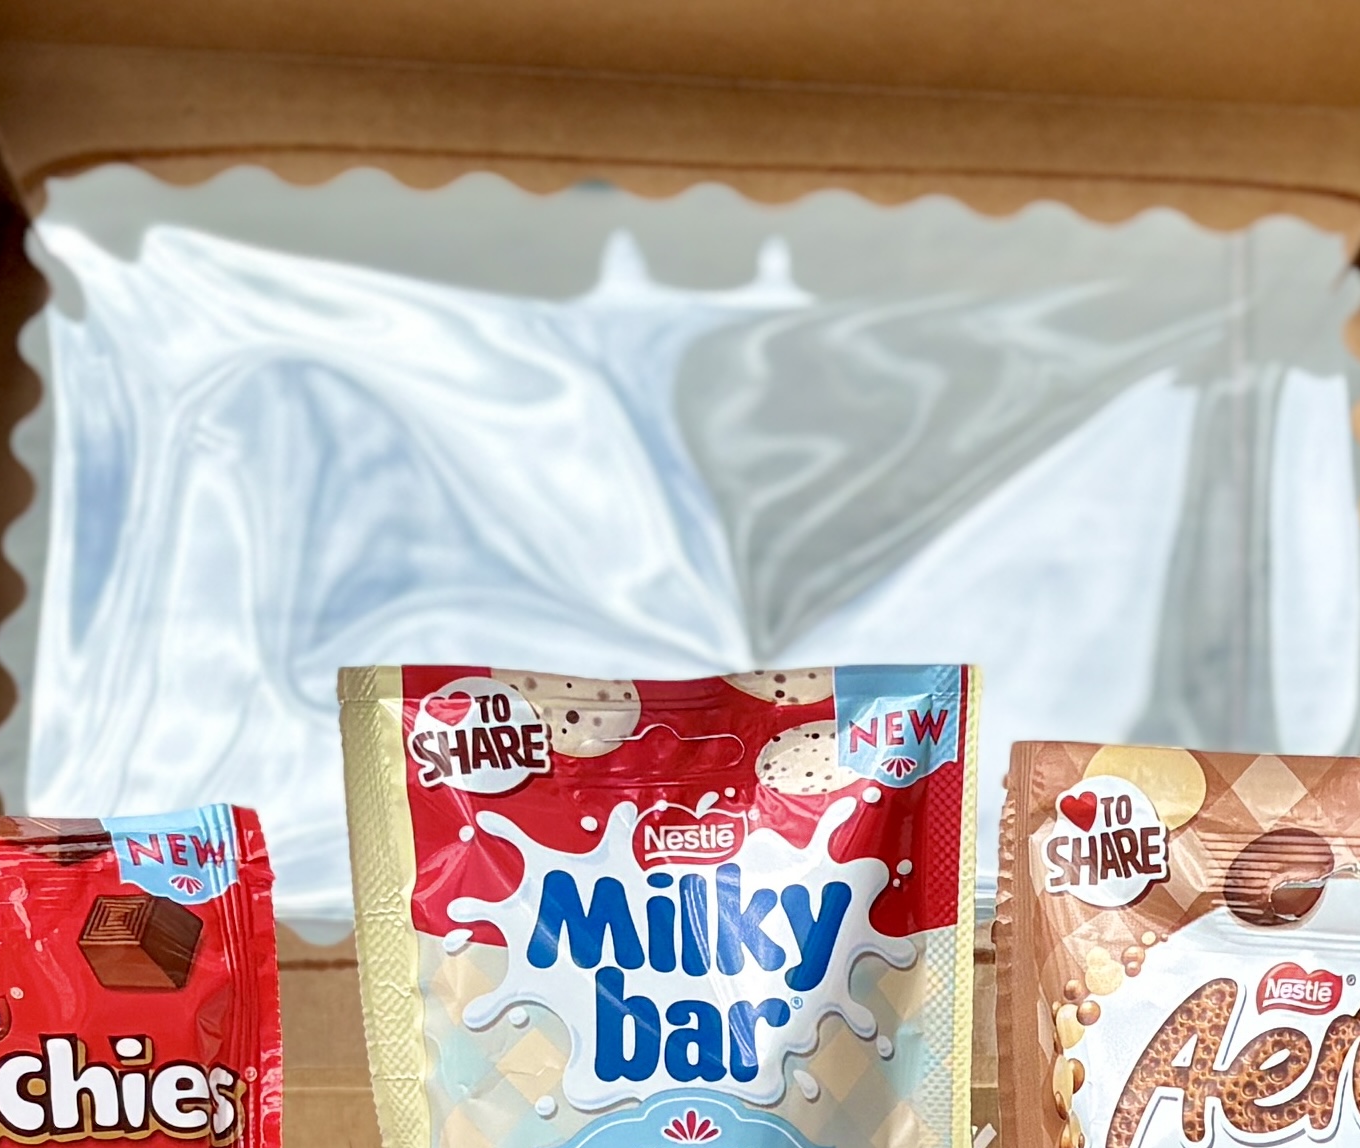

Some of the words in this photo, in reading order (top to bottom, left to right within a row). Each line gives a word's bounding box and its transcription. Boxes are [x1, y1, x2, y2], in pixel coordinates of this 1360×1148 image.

[477, 693, 512, 724] TO
[848, 709, 948, 754] NEW
[413, 724, 548, 782] SHARE
[1104, 795, 1131, 824] TO
[127, 833, 226, 869] NEW
[1048, 828, 1164, 884] SHARE
[527, 863, 852, 992] Milky
[594, 967, 790, 1083] bar
